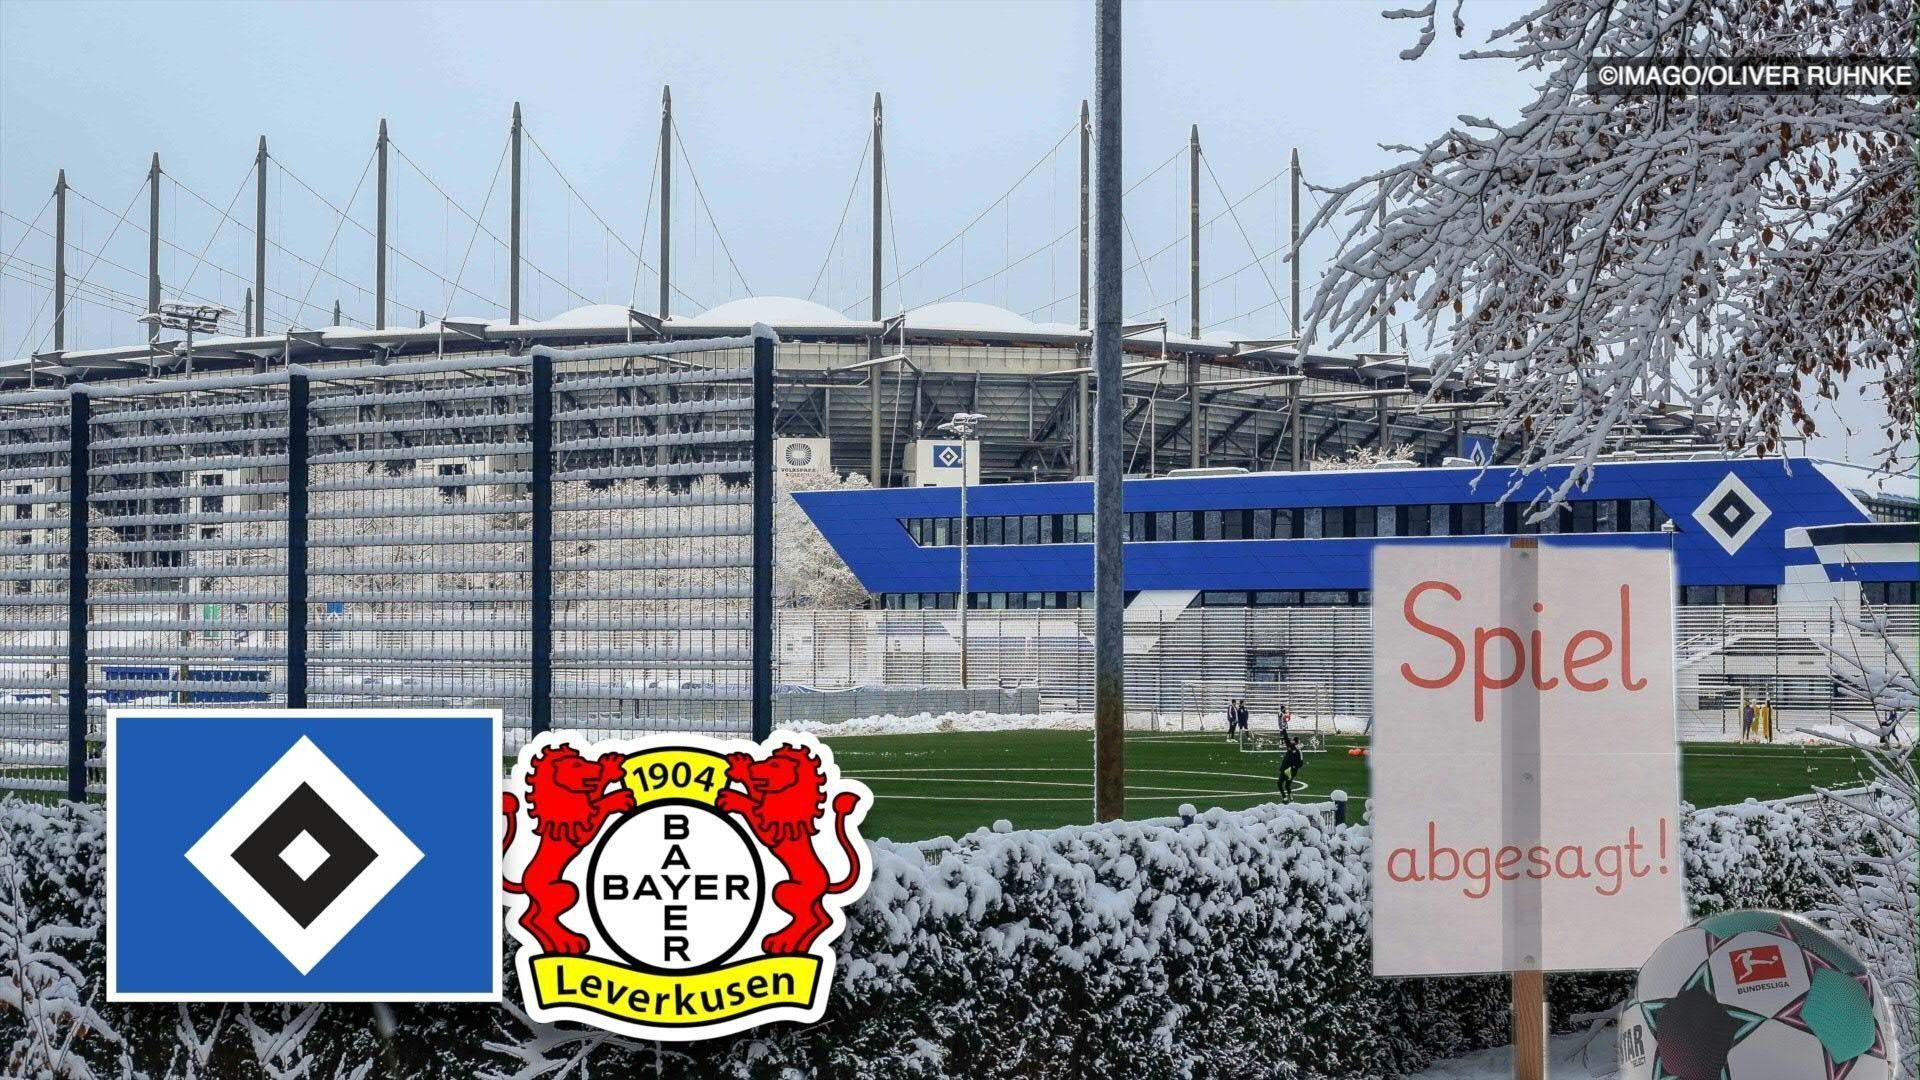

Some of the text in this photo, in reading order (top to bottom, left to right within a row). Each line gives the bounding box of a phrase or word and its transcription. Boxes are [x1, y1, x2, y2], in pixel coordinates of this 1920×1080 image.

[1400, 580, 1648, 722] Spiel
[1386, 817, 1669, 899] abgesagt!
[1737, 981, 1790, 995] BUNDESLIGA
